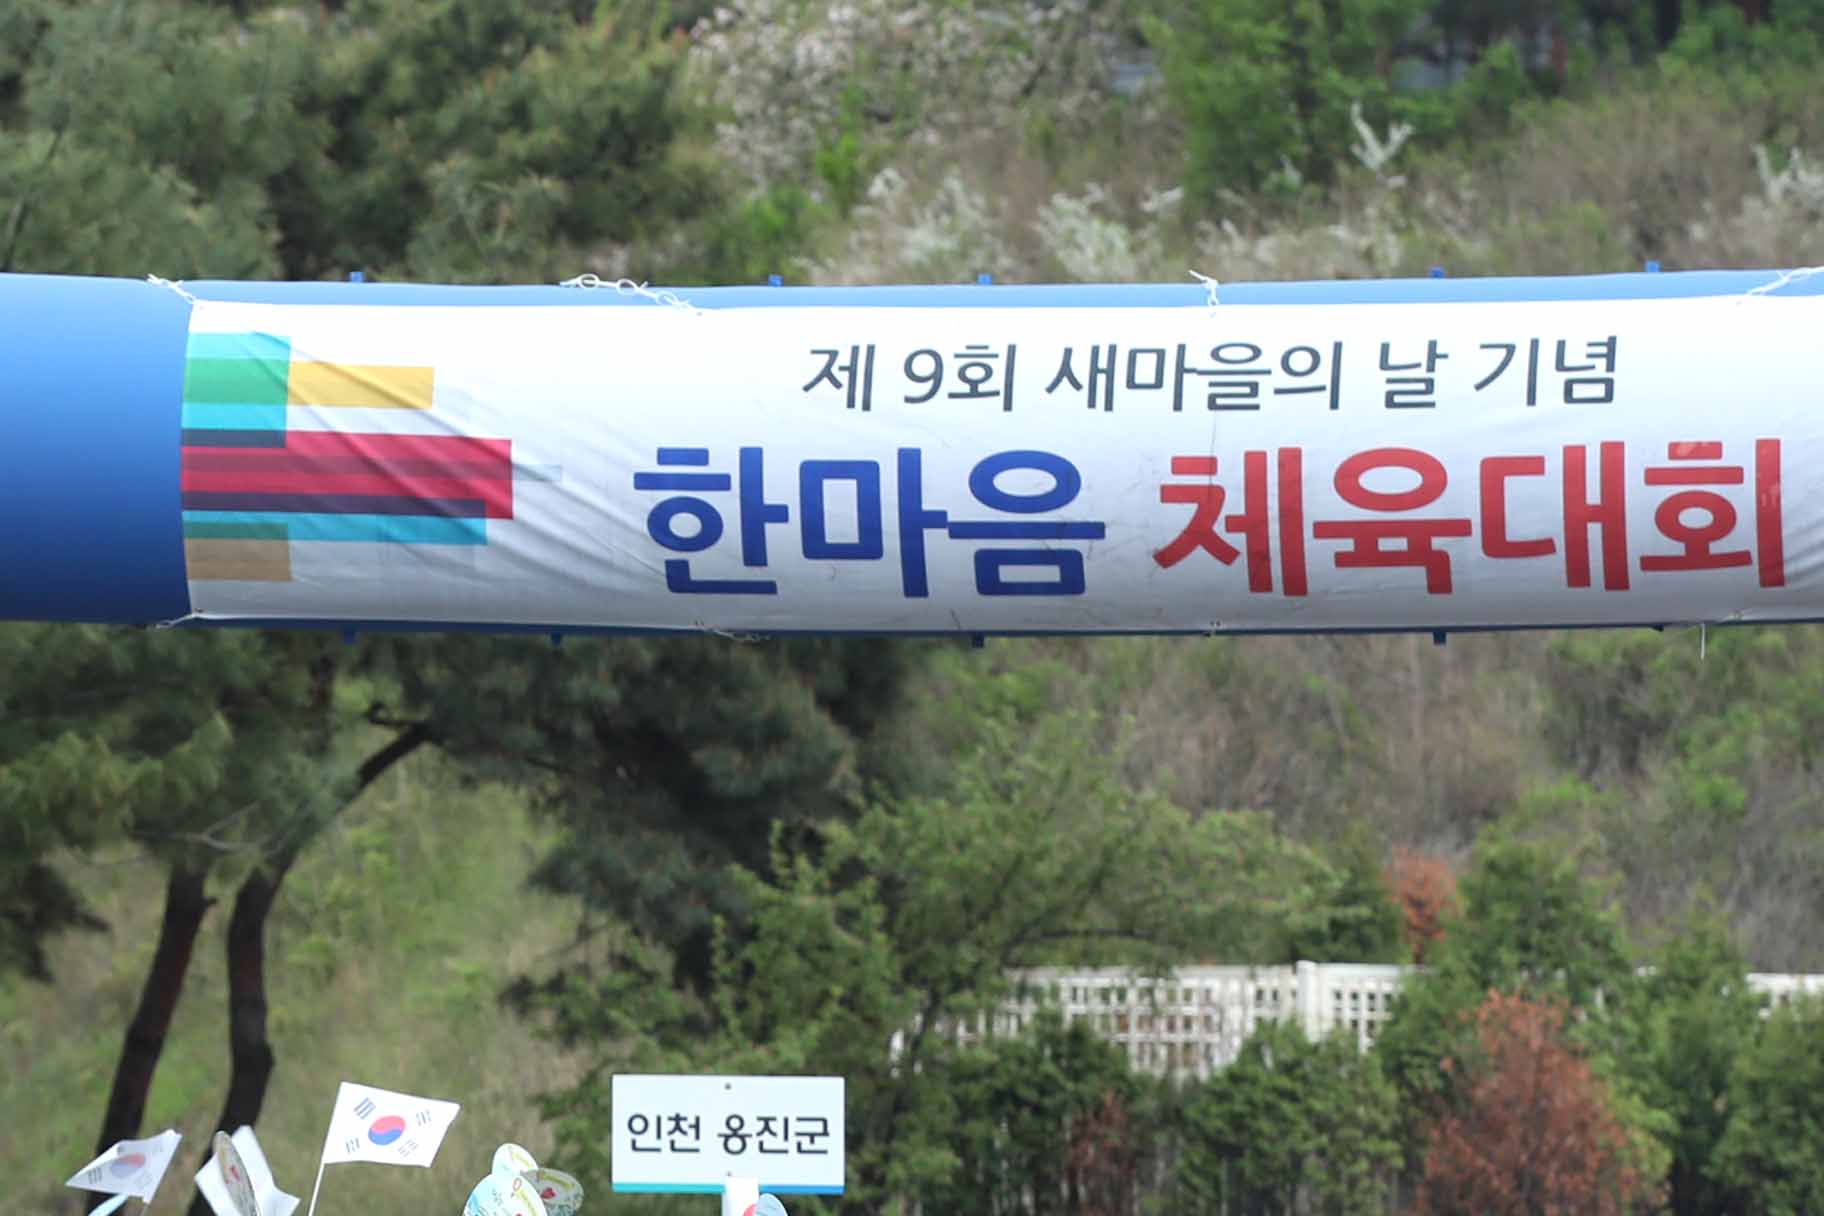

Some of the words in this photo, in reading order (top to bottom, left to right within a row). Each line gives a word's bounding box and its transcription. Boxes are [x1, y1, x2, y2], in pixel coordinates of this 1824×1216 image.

[802, 344, 875, 411] 제
[903, 344, 1016, 411] 9회
[1045, 342, 1343, 412] 새마을의
[1379, 340, 1449, 408] 날
[1474, 336, 1617, 405] 기념
[633, 447, 1106, 598] 한마음
[1153, 439, 1785, 597] 체육대회
[627, 1113, 700, 1153] 인천
[717, 1114, 830, 1155] 옹진군
